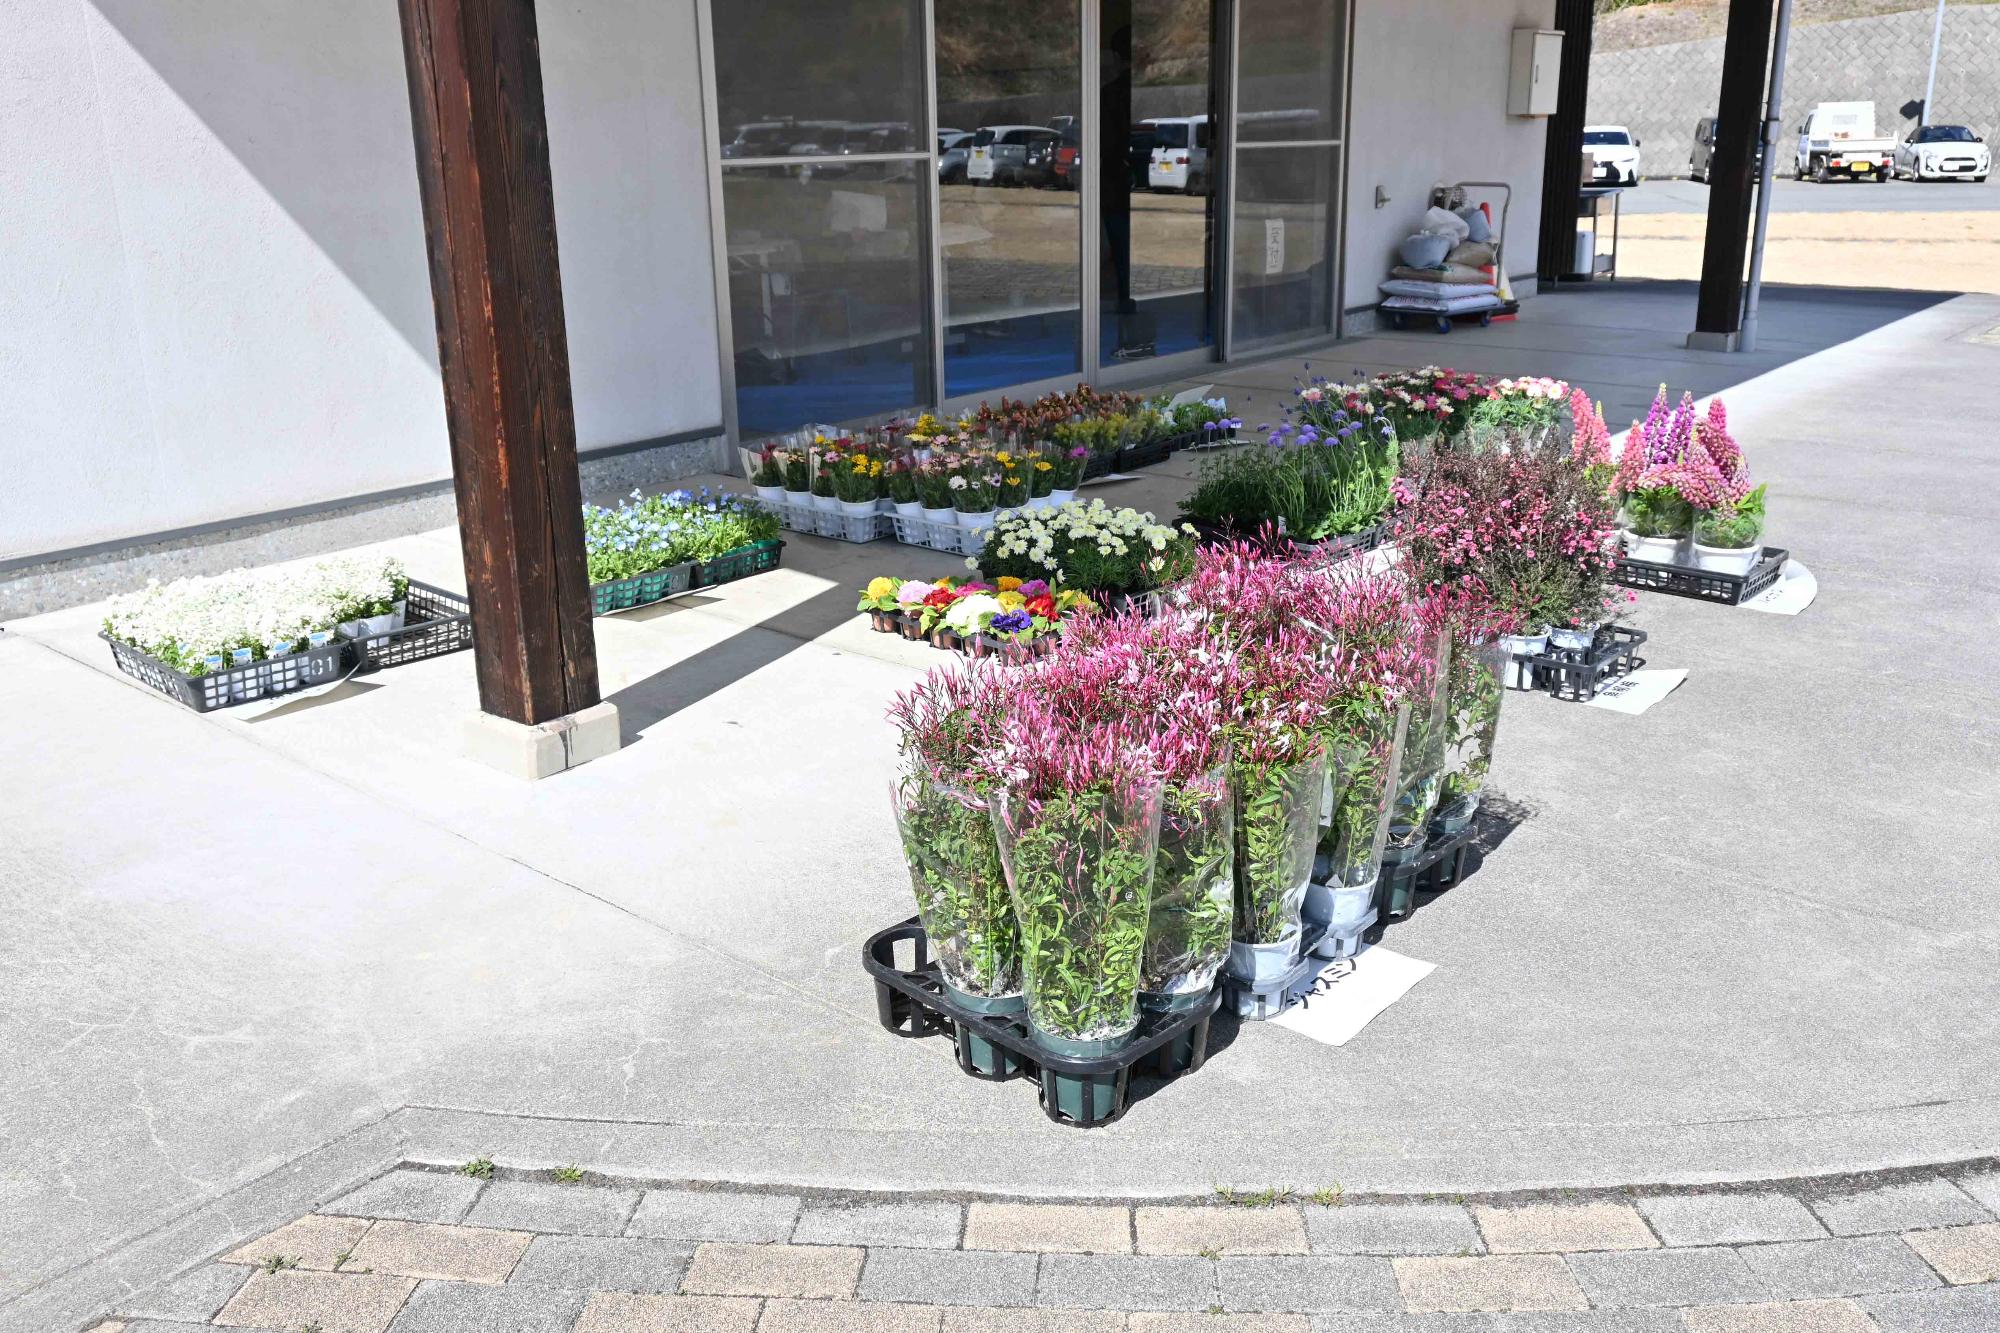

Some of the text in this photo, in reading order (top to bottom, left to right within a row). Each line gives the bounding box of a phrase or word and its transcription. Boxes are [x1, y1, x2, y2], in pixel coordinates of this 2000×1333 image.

[1286, 958, 1357, 1010] ジャスミン
